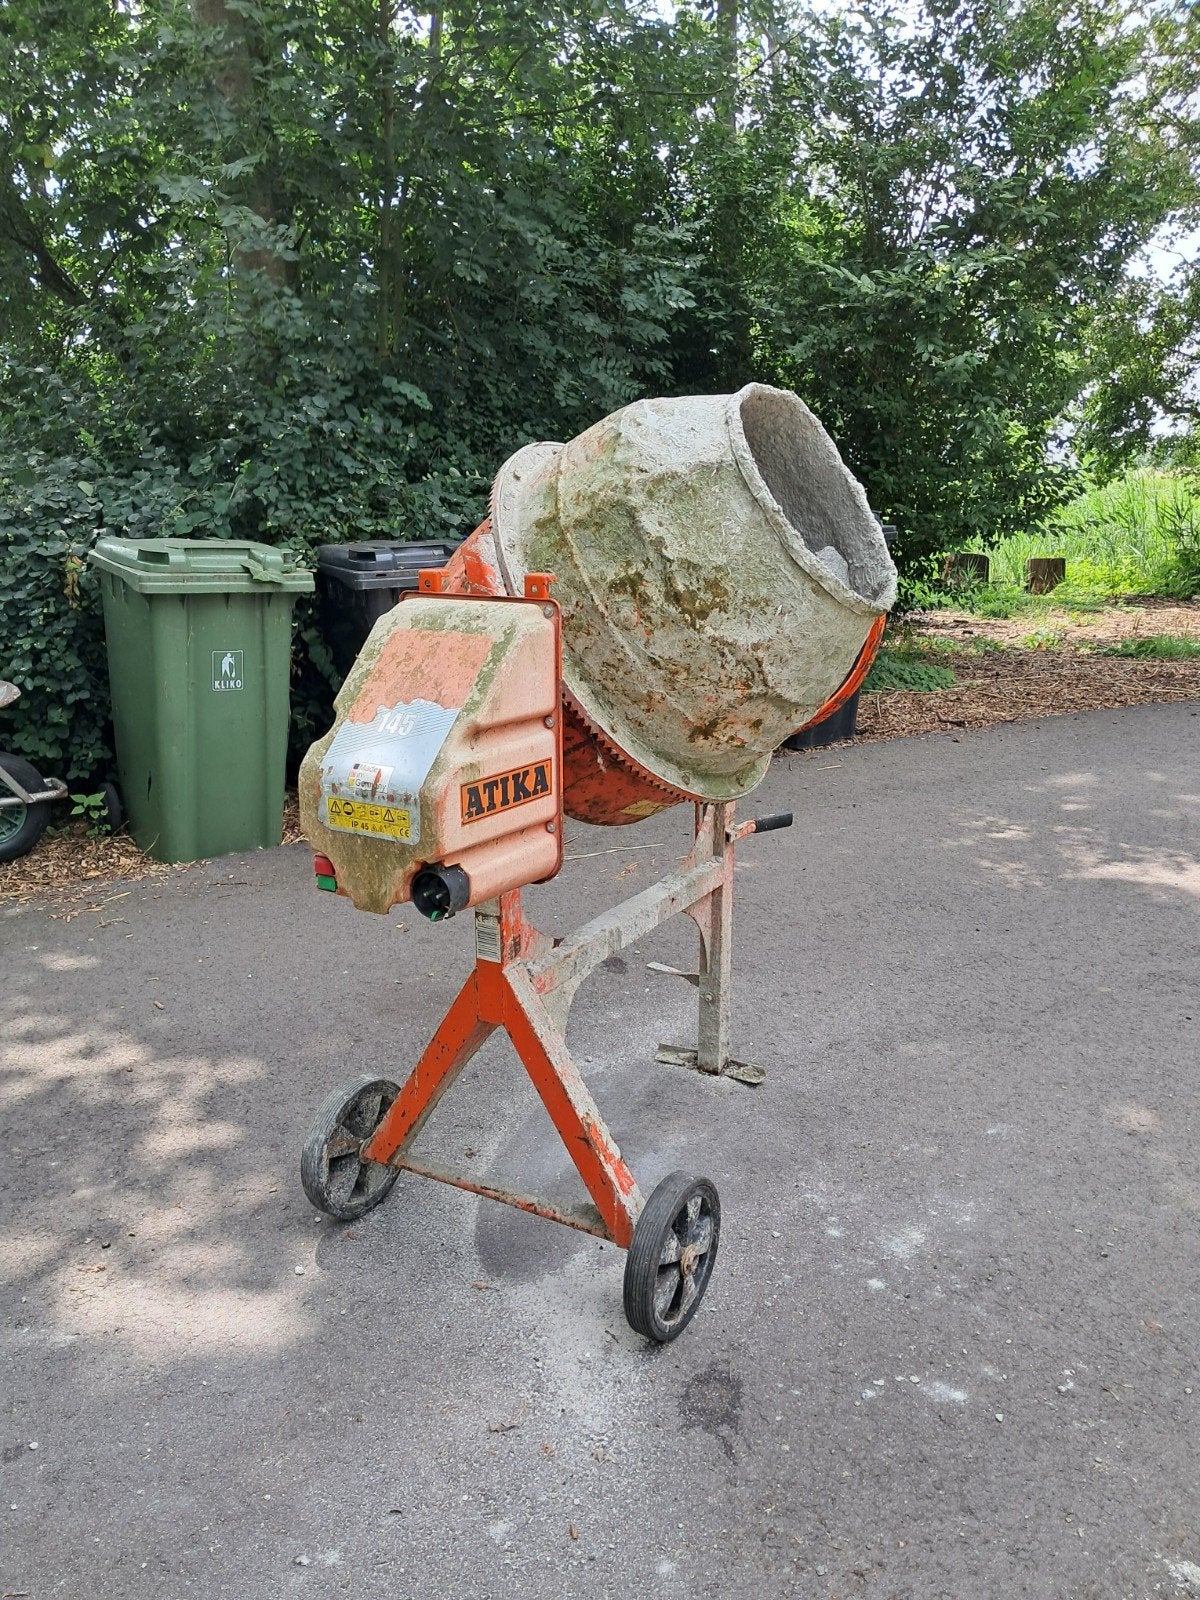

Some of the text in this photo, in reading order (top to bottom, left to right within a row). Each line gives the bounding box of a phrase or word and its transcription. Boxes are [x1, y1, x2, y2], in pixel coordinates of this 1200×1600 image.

[214, 680, 242, 689] KLIKO
[378, 710, 416, 736] 145
[355, 778, 388, 793] Germny
[465, 765, 549, 819] ATIKA
[360, 822, 370, 831] 45
